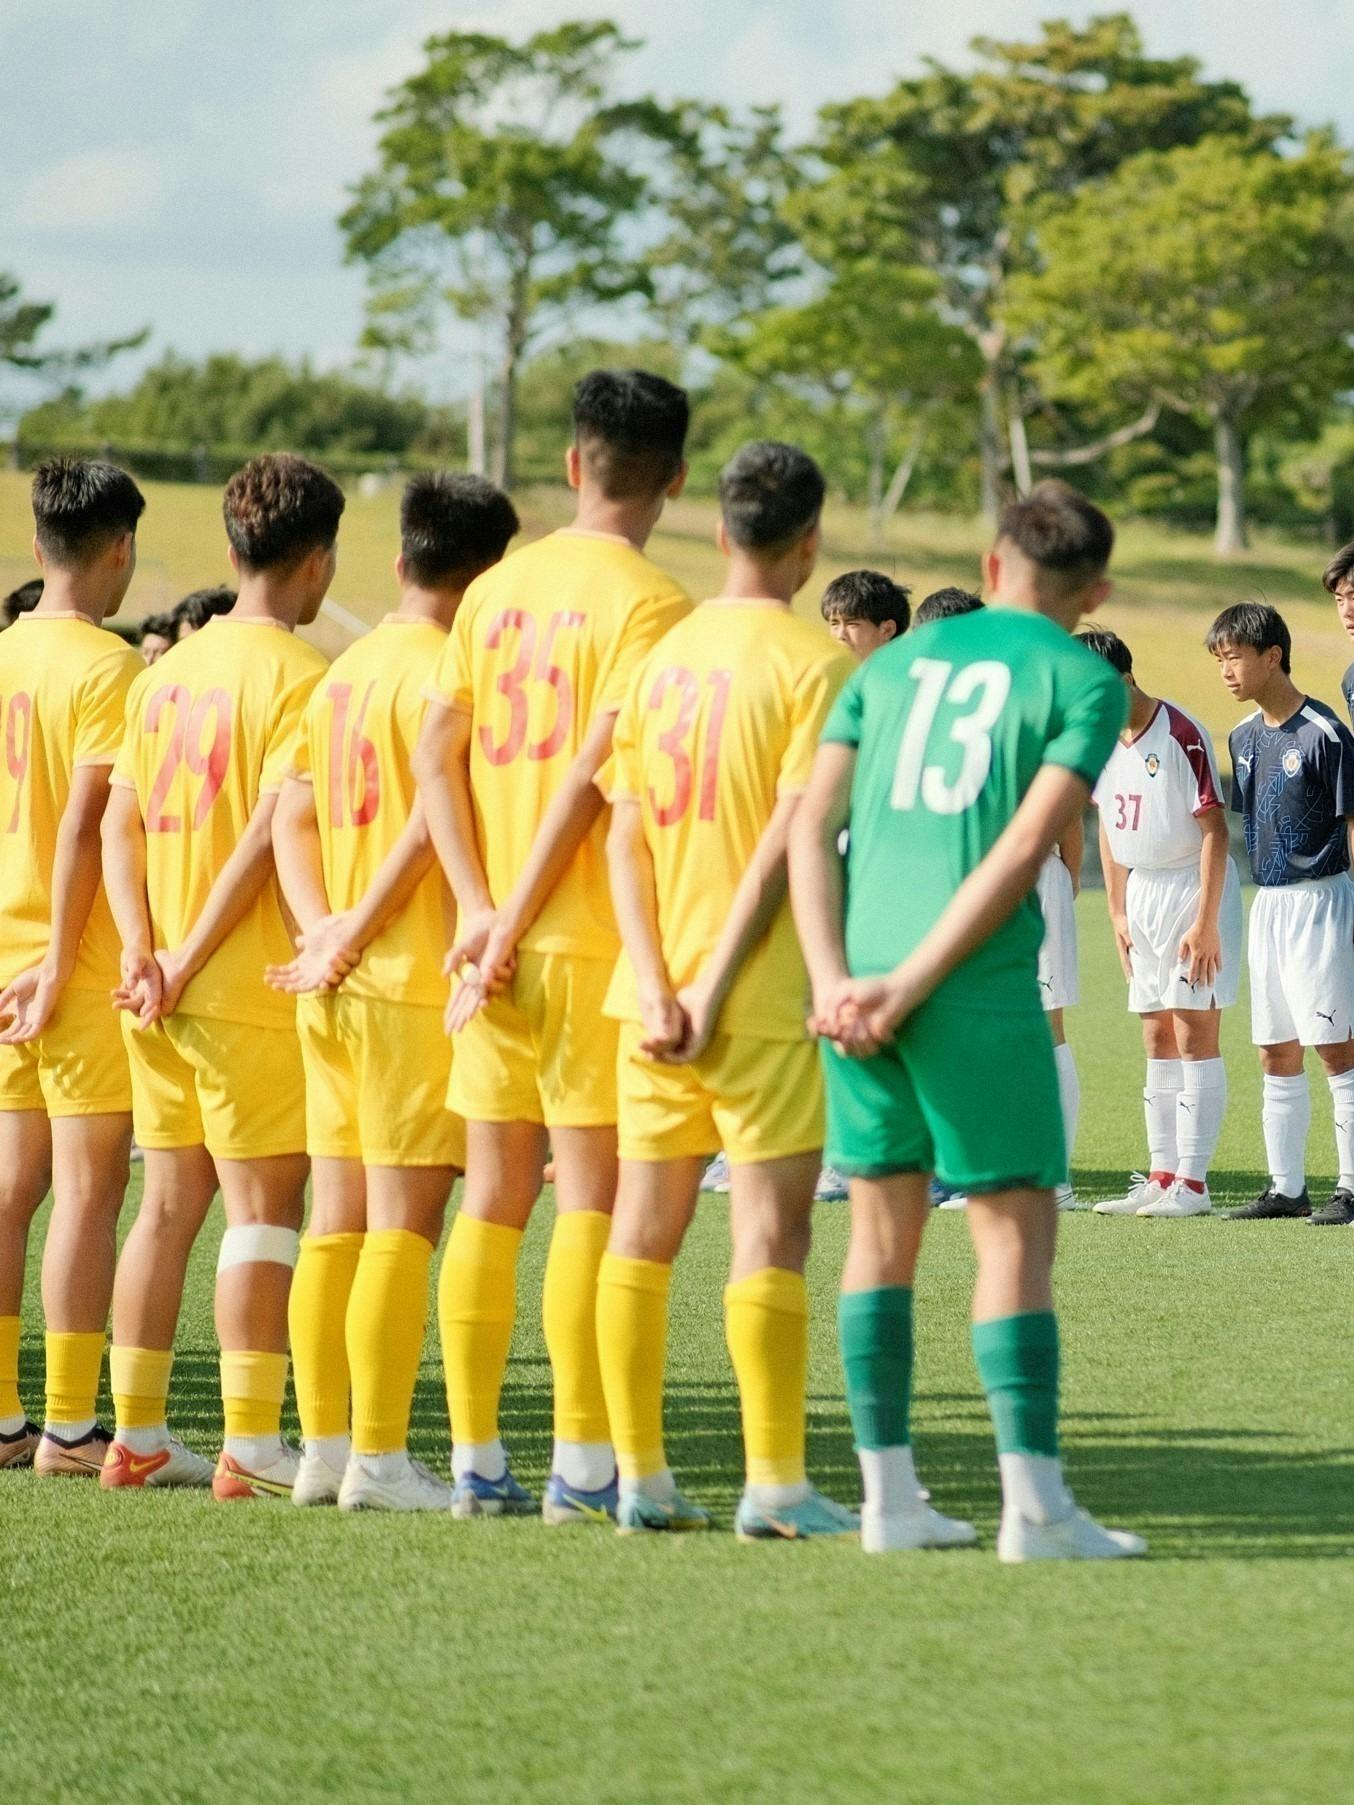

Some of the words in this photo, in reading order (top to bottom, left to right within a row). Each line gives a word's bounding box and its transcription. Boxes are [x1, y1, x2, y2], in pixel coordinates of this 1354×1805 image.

[145, 684, 231, 833] 29
[327, 679, 379, 829] 16
[479, 609, 585, 766] 35
[647, 665, 732, 827] 31
[891, 657, 1011, 815] 13
[1115, 793, 1142, 831] 37
